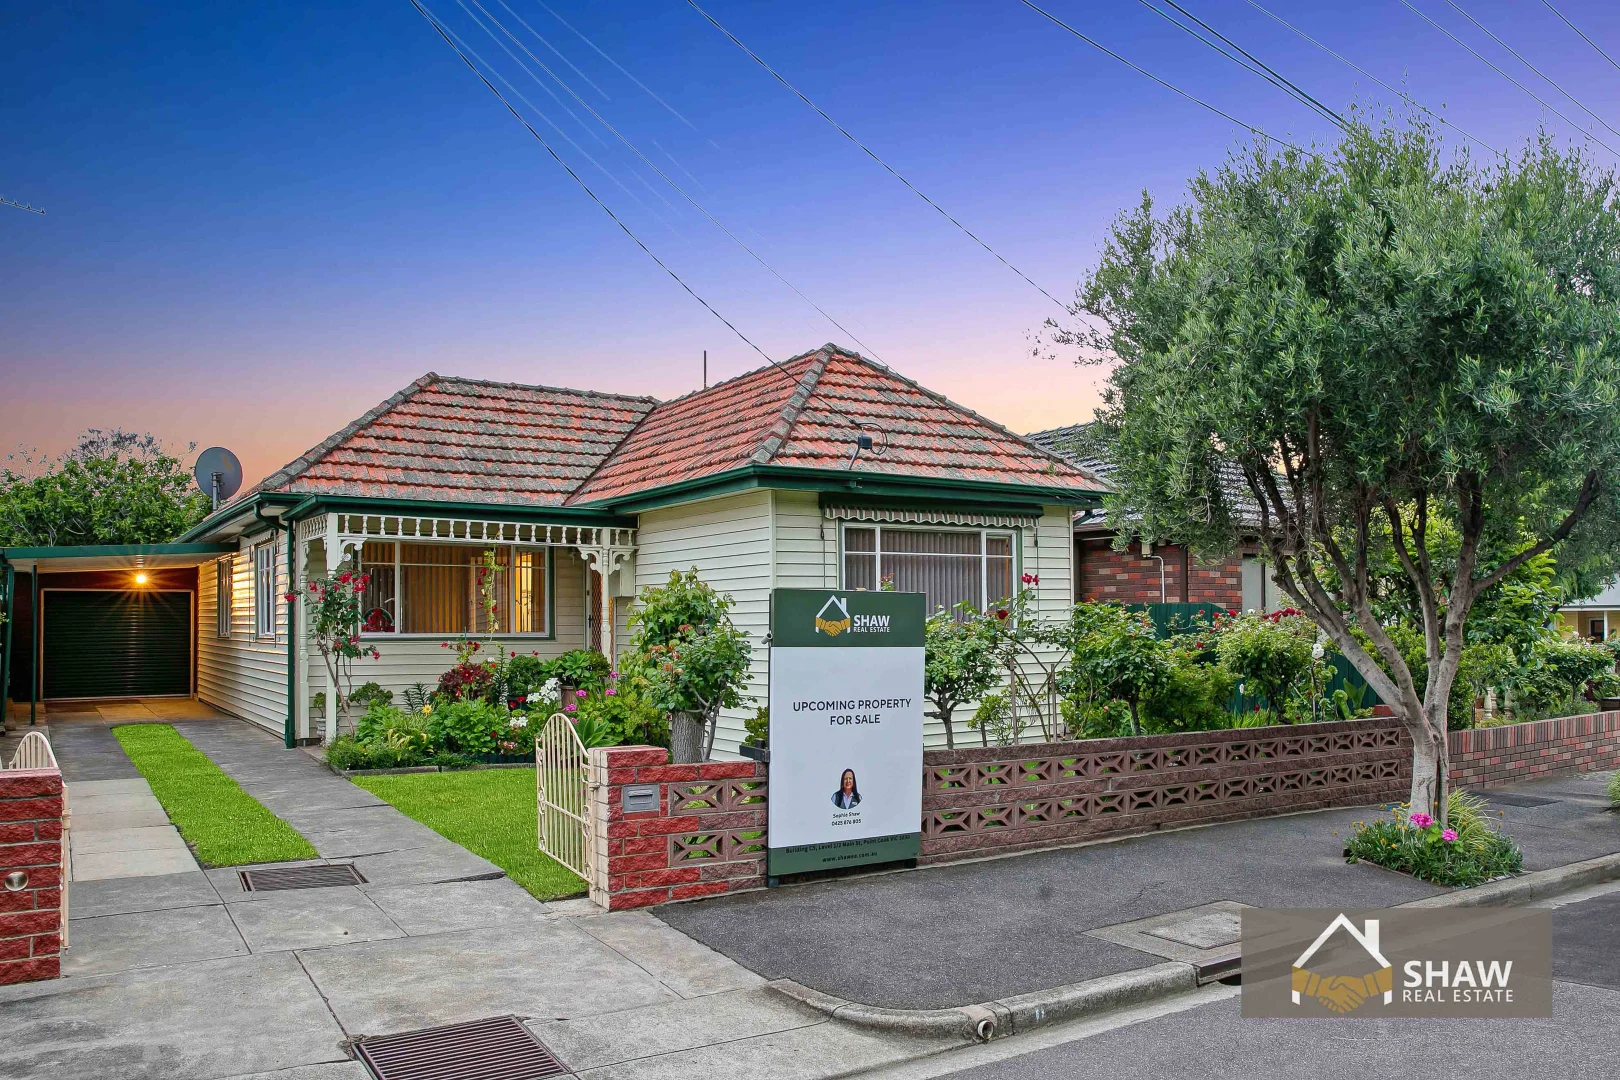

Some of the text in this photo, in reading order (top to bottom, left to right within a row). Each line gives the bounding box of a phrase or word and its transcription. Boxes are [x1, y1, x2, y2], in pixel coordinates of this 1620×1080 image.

[853, 614, 890, 627] SHAW
[793, 698, 912, 712] UPCOMING PROPERTY
[830, 714, 881, 725] FOR SALE
[785, 846, 808, 854] Building
